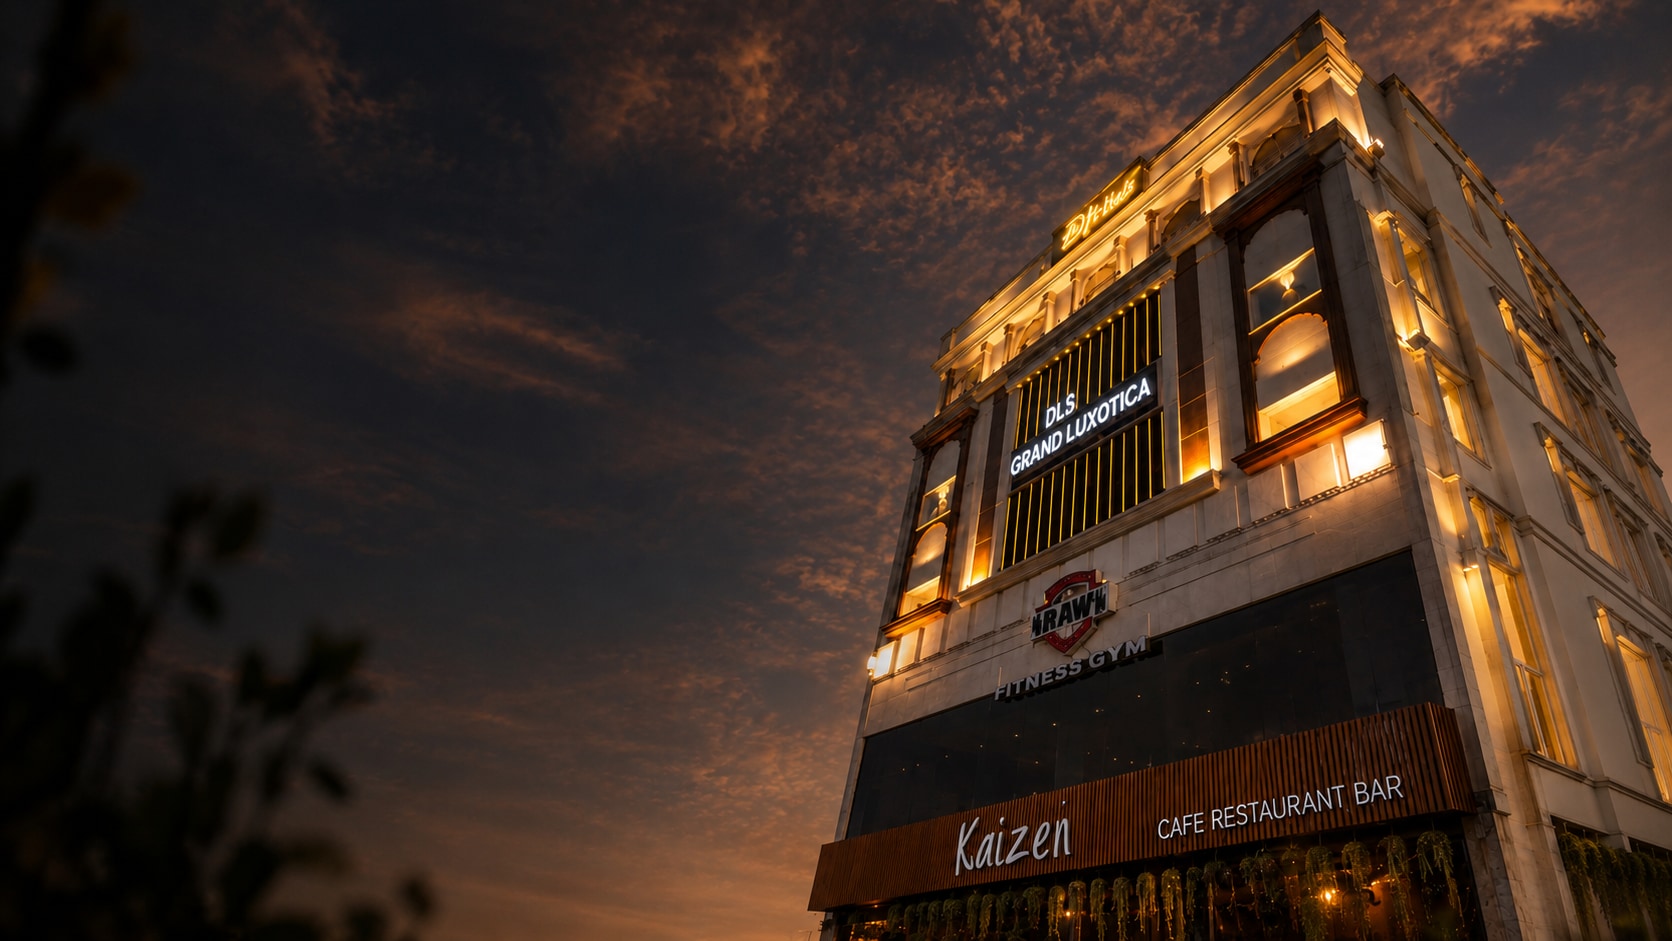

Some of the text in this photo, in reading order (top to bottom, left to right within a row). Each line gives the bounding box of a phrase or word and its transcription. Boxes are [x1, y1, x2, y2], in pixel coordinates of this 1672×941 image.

[1010, 377, 1151, 476] GRAND LUXOTICA
[1045, 393, 1075, 429] DLS
[994, 635, 1147, 700] FITNESS GYM
[1157, 775, 1404, 840] CAFE RESTAURANT BAR
[955, 816, 1071, 876] Kaizen
